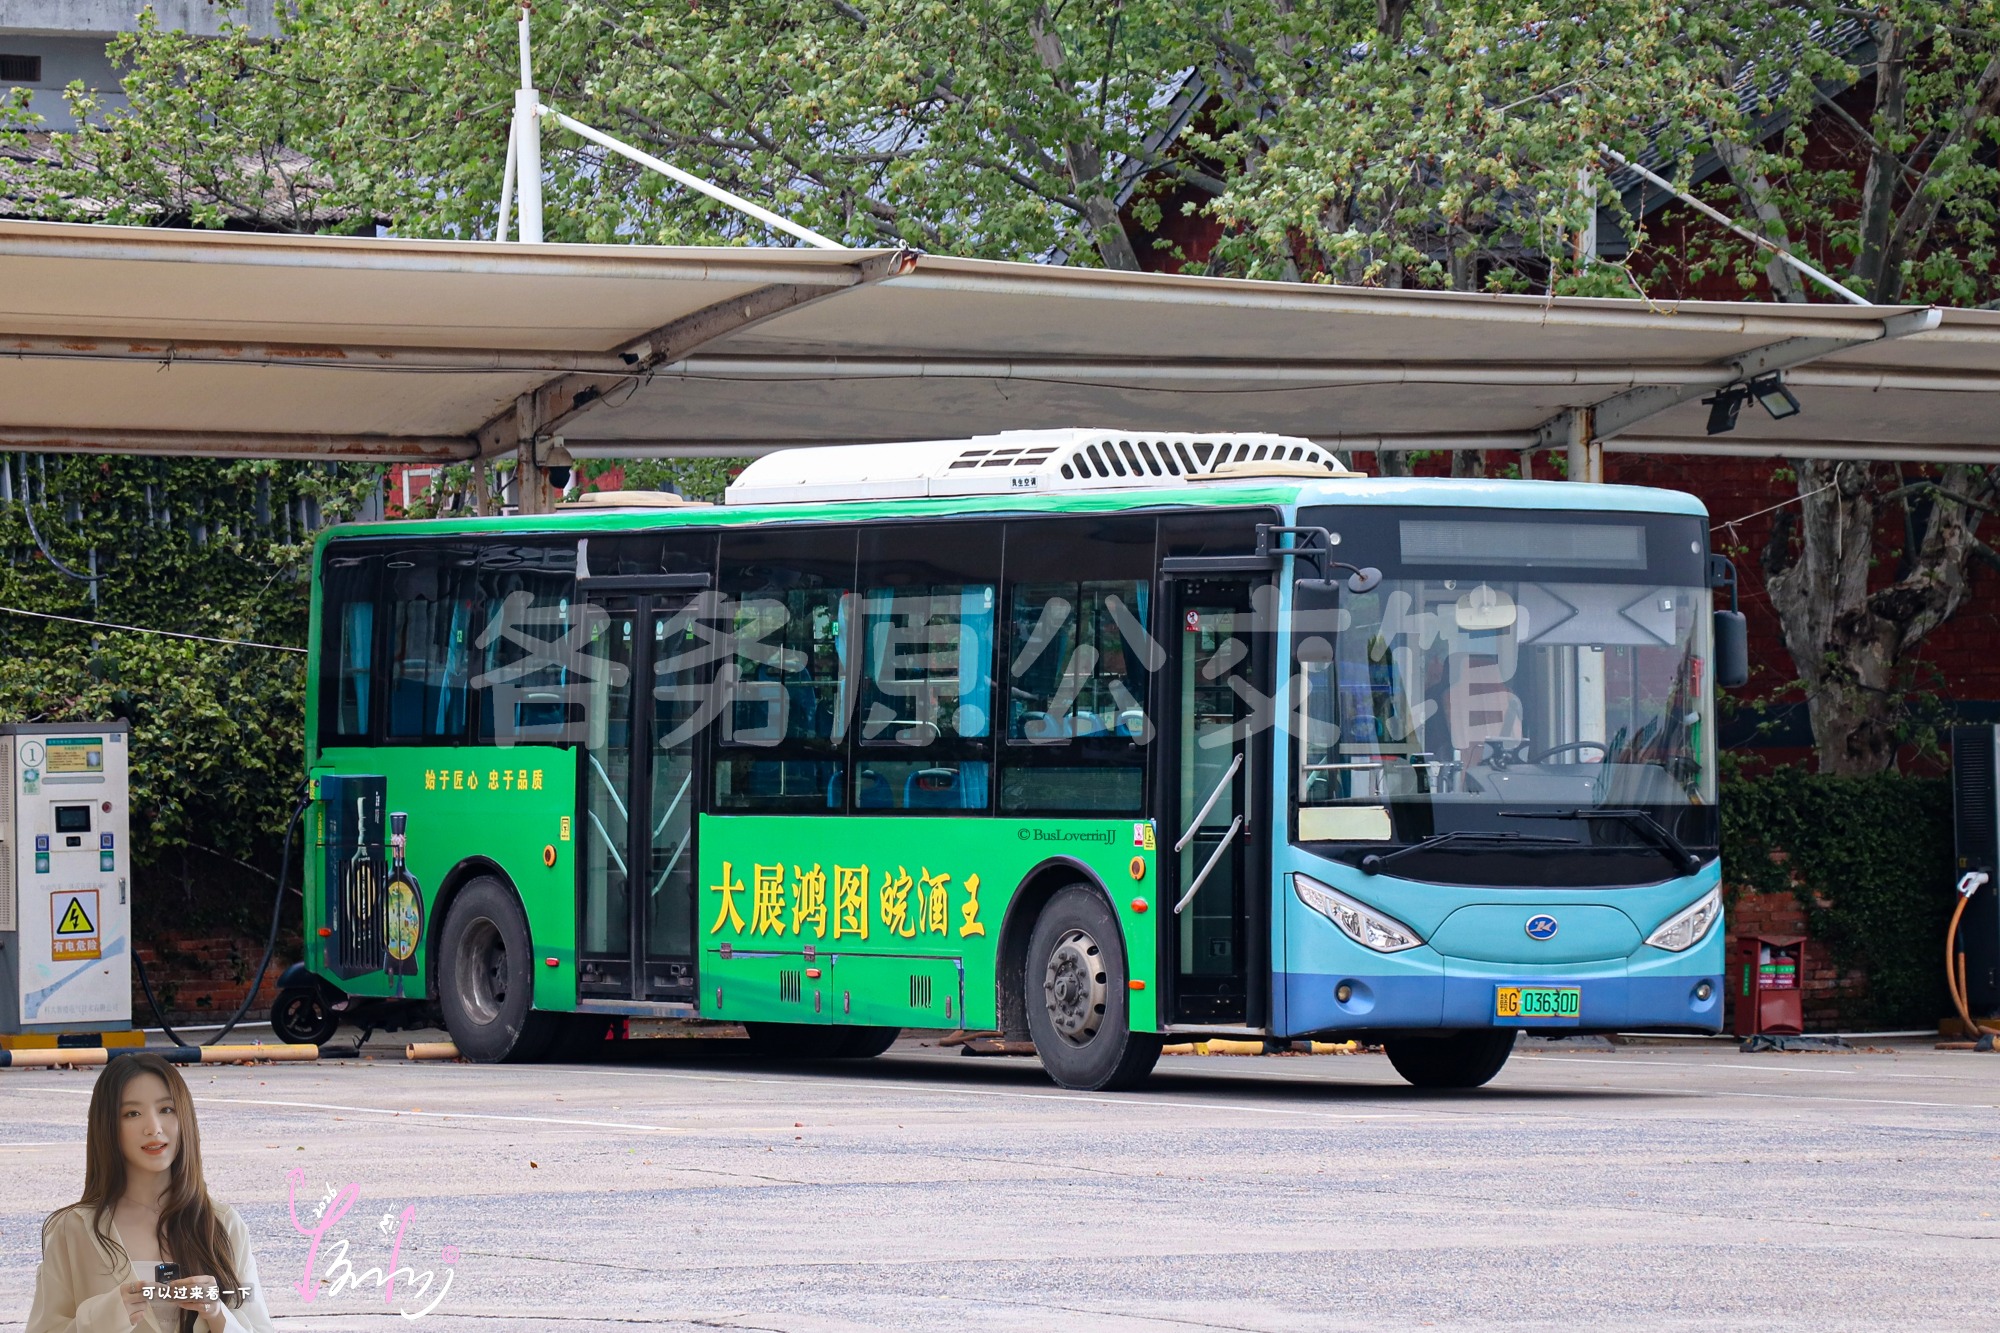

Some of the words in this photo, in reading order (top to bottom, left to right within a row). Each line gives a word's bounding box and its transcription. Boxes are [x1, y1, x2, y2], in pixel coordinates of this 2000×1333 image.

[425, 769, 479, 790] 始于匠心
[488, 769, 543, 790] 忠于品质
[710, 861, 869, 940] 大展鸿图
[880, 865, 985, 938] 皖酒王
[53, 939, 98, 953] 有电危险
